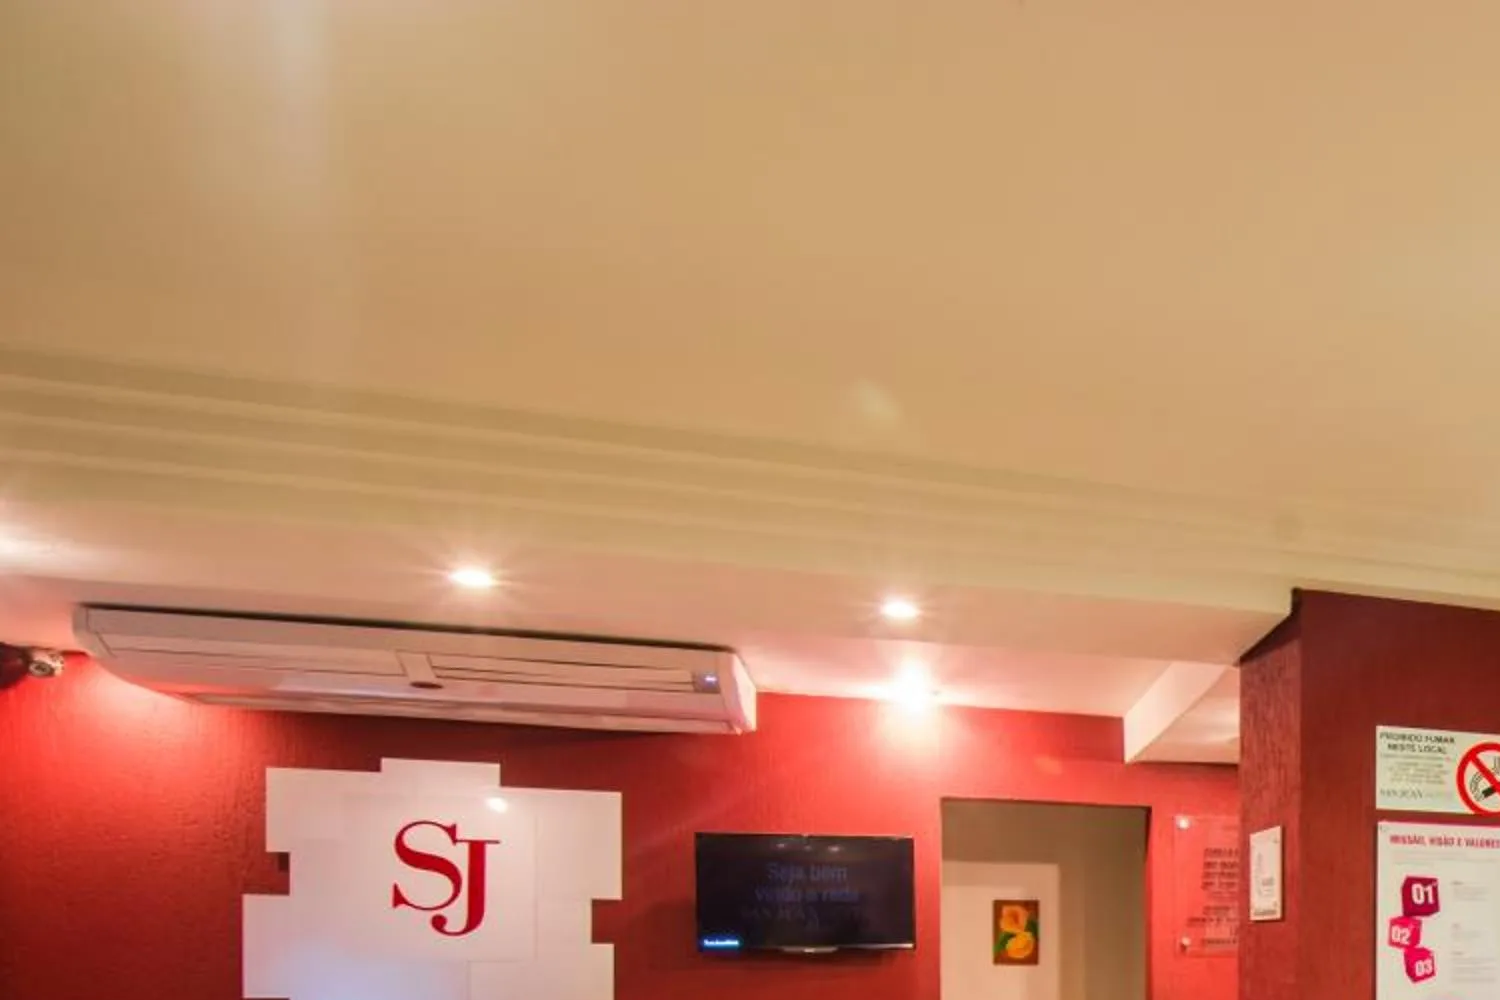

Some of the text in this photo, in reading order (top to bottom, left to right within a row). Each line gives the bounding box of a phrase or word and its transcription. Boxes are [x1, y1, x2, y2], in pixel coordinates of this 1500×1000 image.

[1418, 745, 1447, 755] LOCAL
[392, 820, 500, 937] SJ
[1411, 883, 1434, 905] 01
[1391, 925, 1411, 945] 02
[1415, 959, 1433, 977] 03
